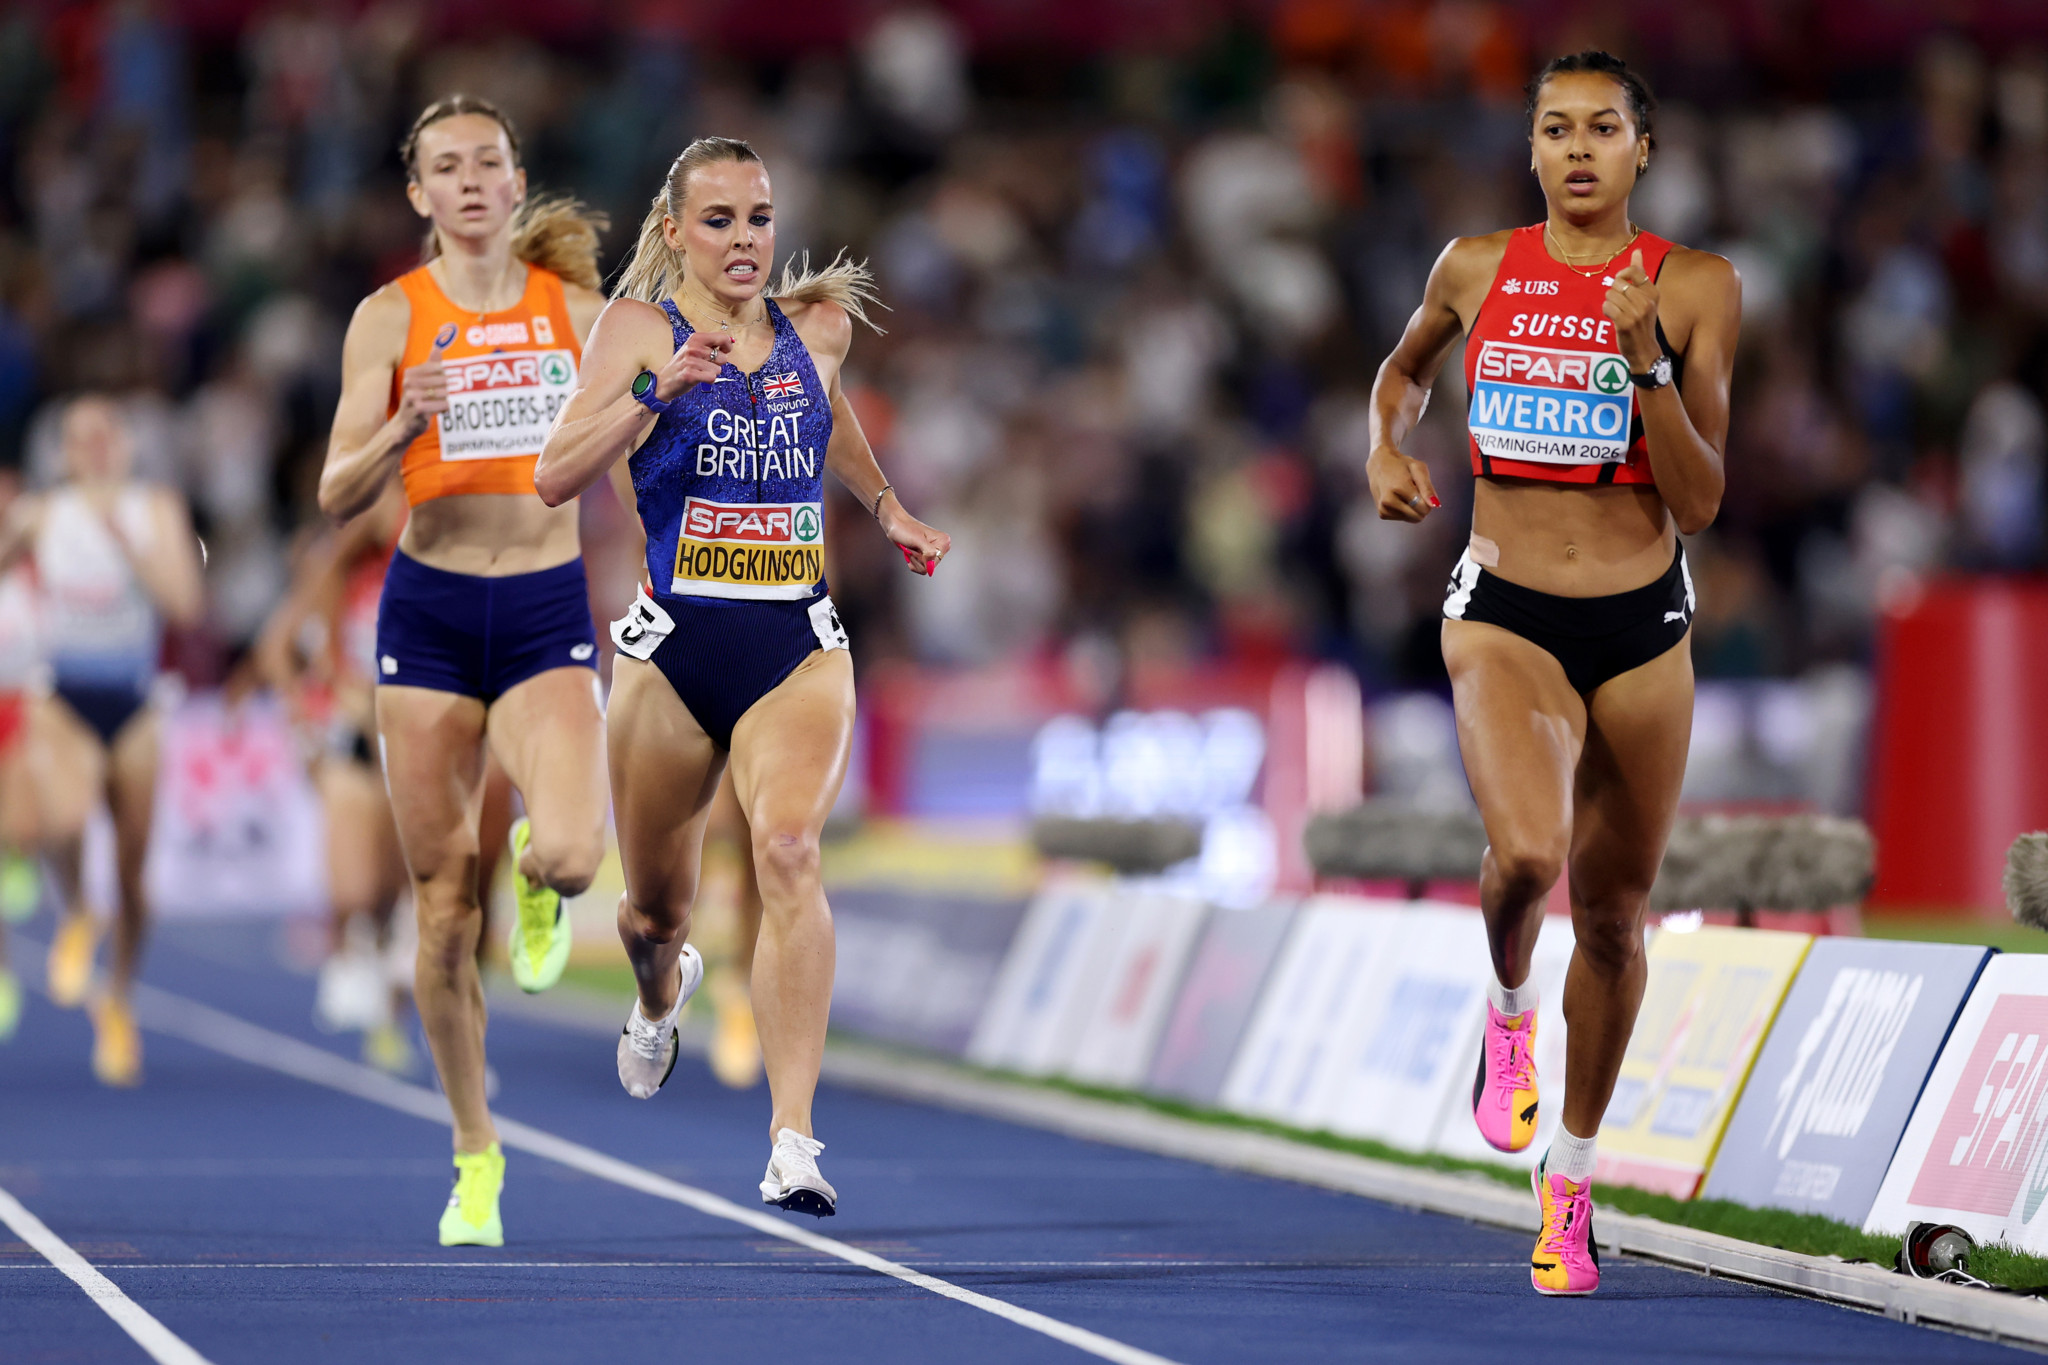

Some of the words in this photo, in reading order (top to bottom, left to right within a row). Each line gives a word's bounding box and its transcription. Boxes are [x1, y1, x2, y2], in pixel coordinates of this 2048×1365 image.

[1524, 281, 1559, 295] UBS
[444, 359, 537, 393] SPAR
[1482, 350, 1585, 386] SPAR
[767, 398, 809, 414] Novuna
[1478, 389, 1623, 436] WERRO
[707, 408, 803, 449] GREAT
[1474, 433, 1576, 457] BIRMINGHAM
[1580, 445, 1620, 459] 2026
[696, 444, 815, 481] BRITAIN
[689, 507, 790, 537] SPAR
[678, 543, 820, 581] HODGKINSON
